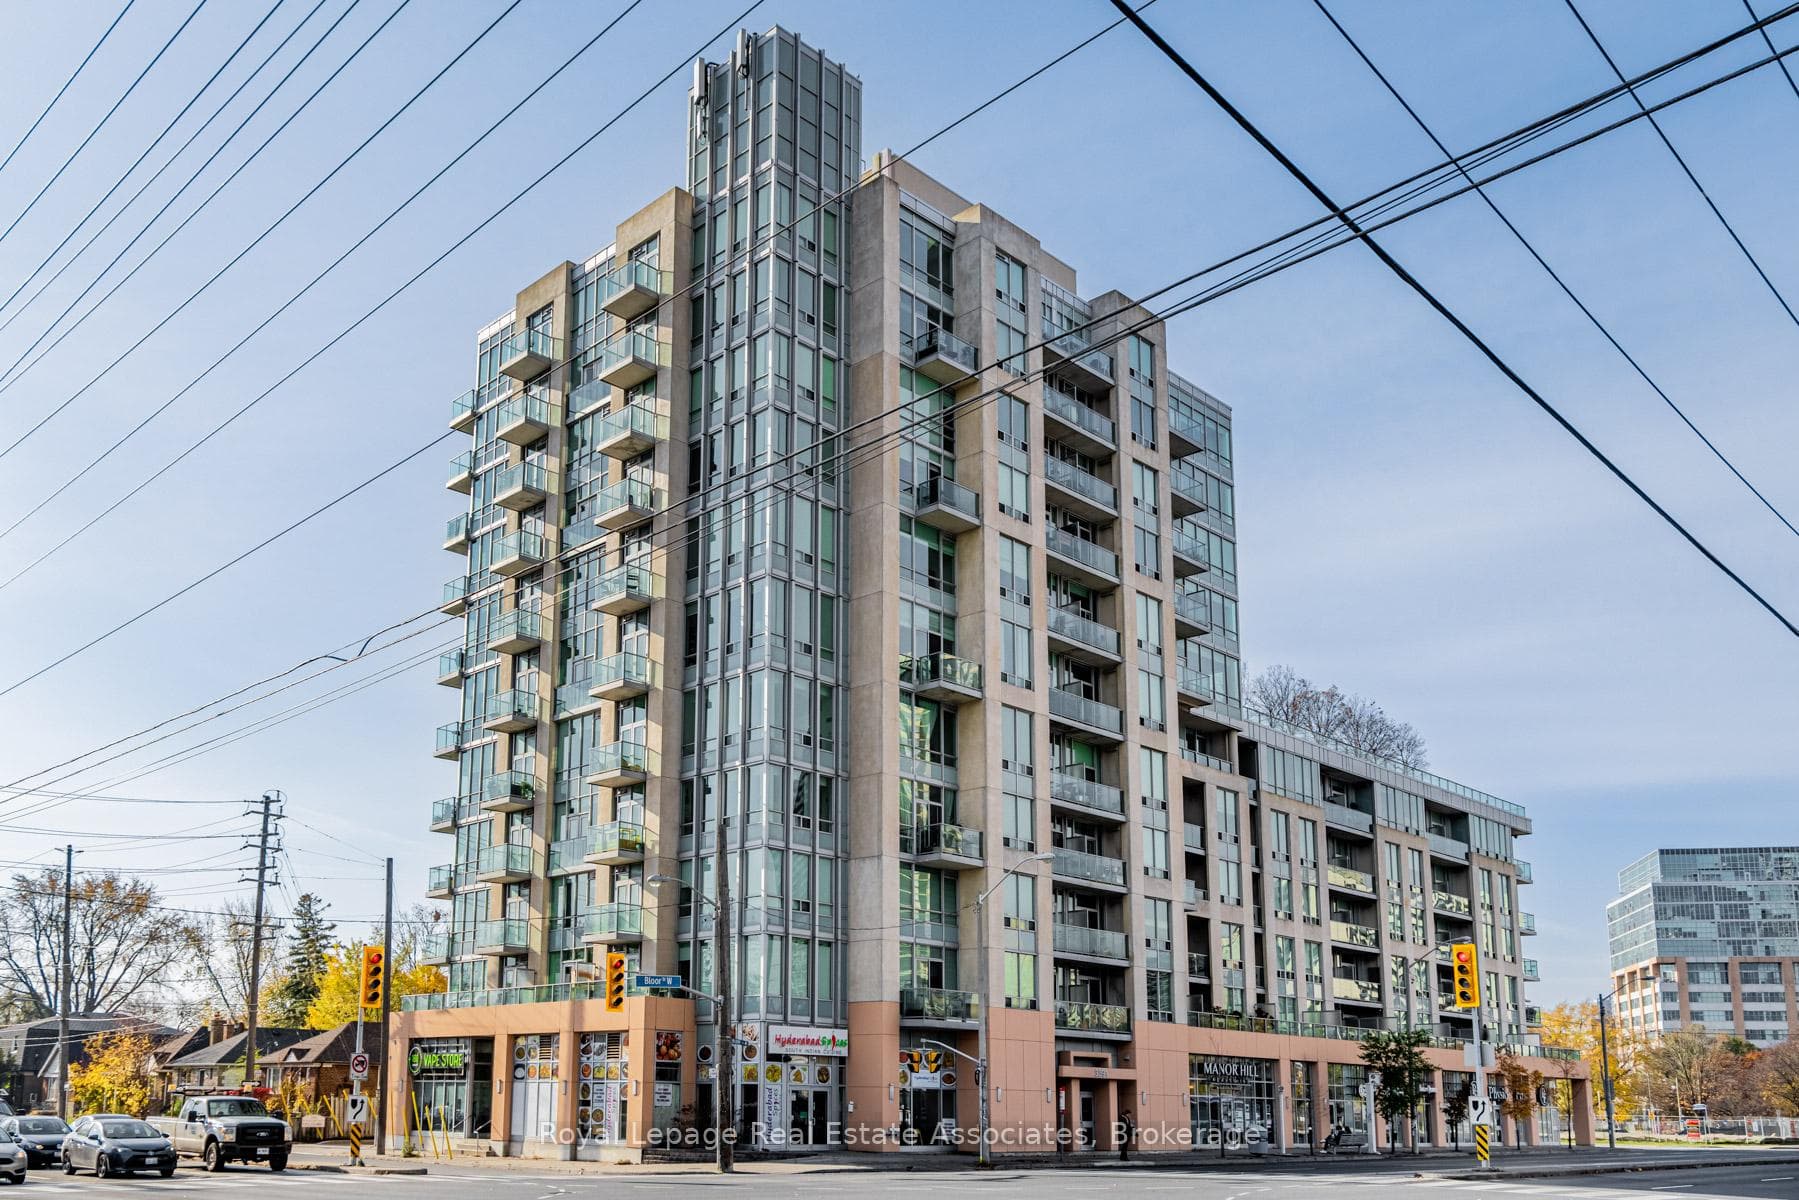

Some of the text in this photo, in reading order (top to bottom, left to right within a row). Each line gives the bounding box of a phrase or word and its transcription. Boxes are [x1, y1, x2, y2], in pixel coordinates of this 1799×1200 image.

[644, 976, 661, 985] Bloor
[666, 977, 673, 985] W
[774, 1033, 821, 1048] Hyderabad
[423, 1053, 440, 1067] VAPE
[441, 1053, 462, 1067] STORE
[1203, 1062, 1259, 1078] MANOR HILL
[765, 1087, 773, 1142] Hyderabad
